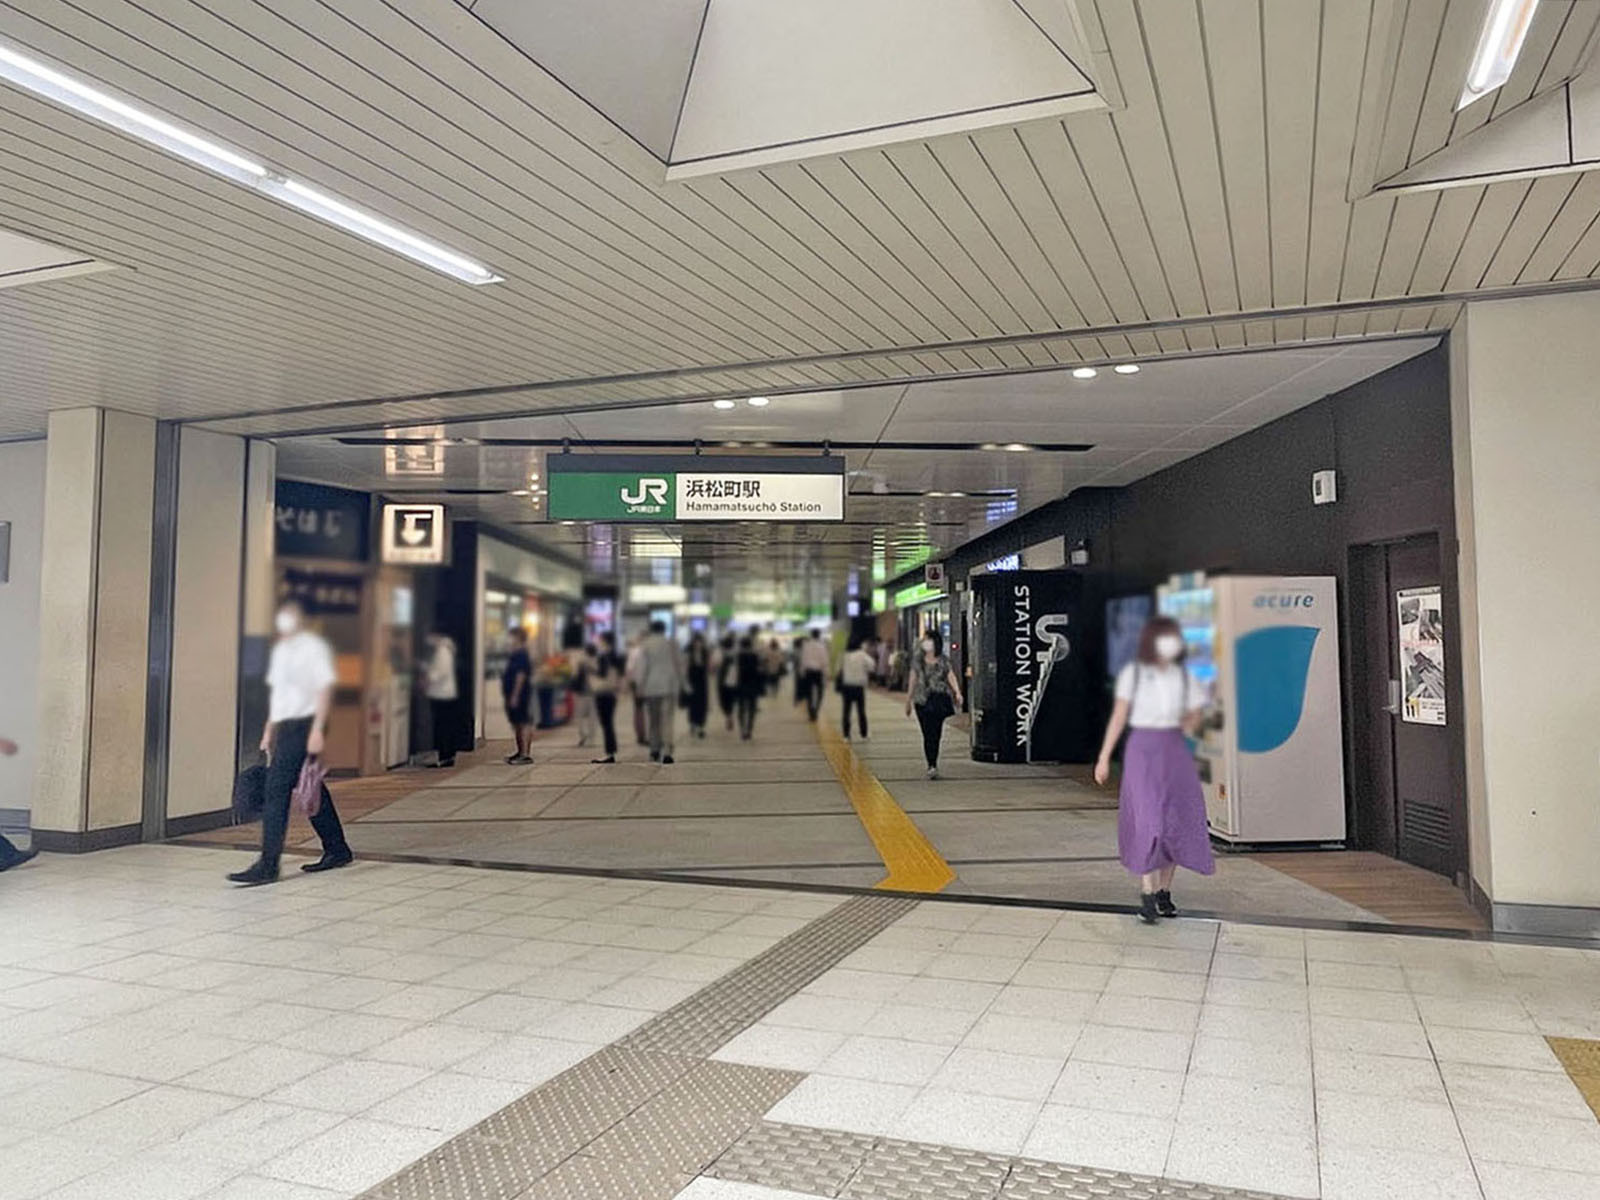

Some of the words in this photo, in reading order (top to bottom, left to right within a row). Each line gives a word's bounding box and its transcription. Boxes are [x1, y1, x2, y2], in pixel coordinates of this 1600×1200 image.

[621, 478, 668, 505] JR
[686, 479, 761, 498] 浜松町駅
[780, 502, 822, 512] Station
[1014, 584, 1031, 676] STATION
